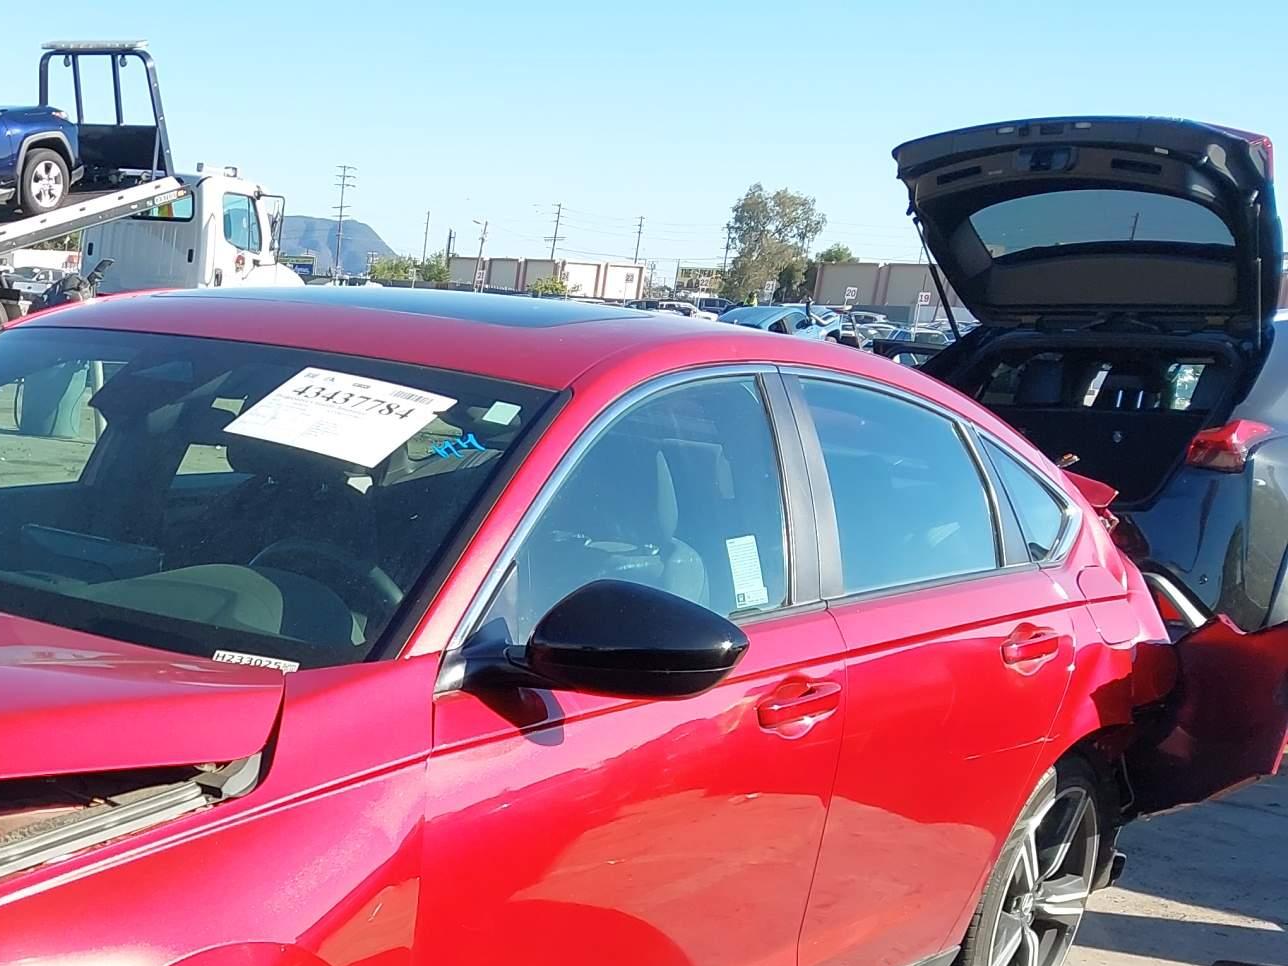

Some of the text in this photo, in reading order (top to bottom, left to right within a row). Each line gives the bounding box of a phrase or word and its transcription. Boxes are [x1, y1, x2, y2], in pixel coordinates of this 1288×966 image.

[846, 288, 856, 297] 20
[919, 294, 930, 302] 19
[293, 384, 415, 420] 43437784
